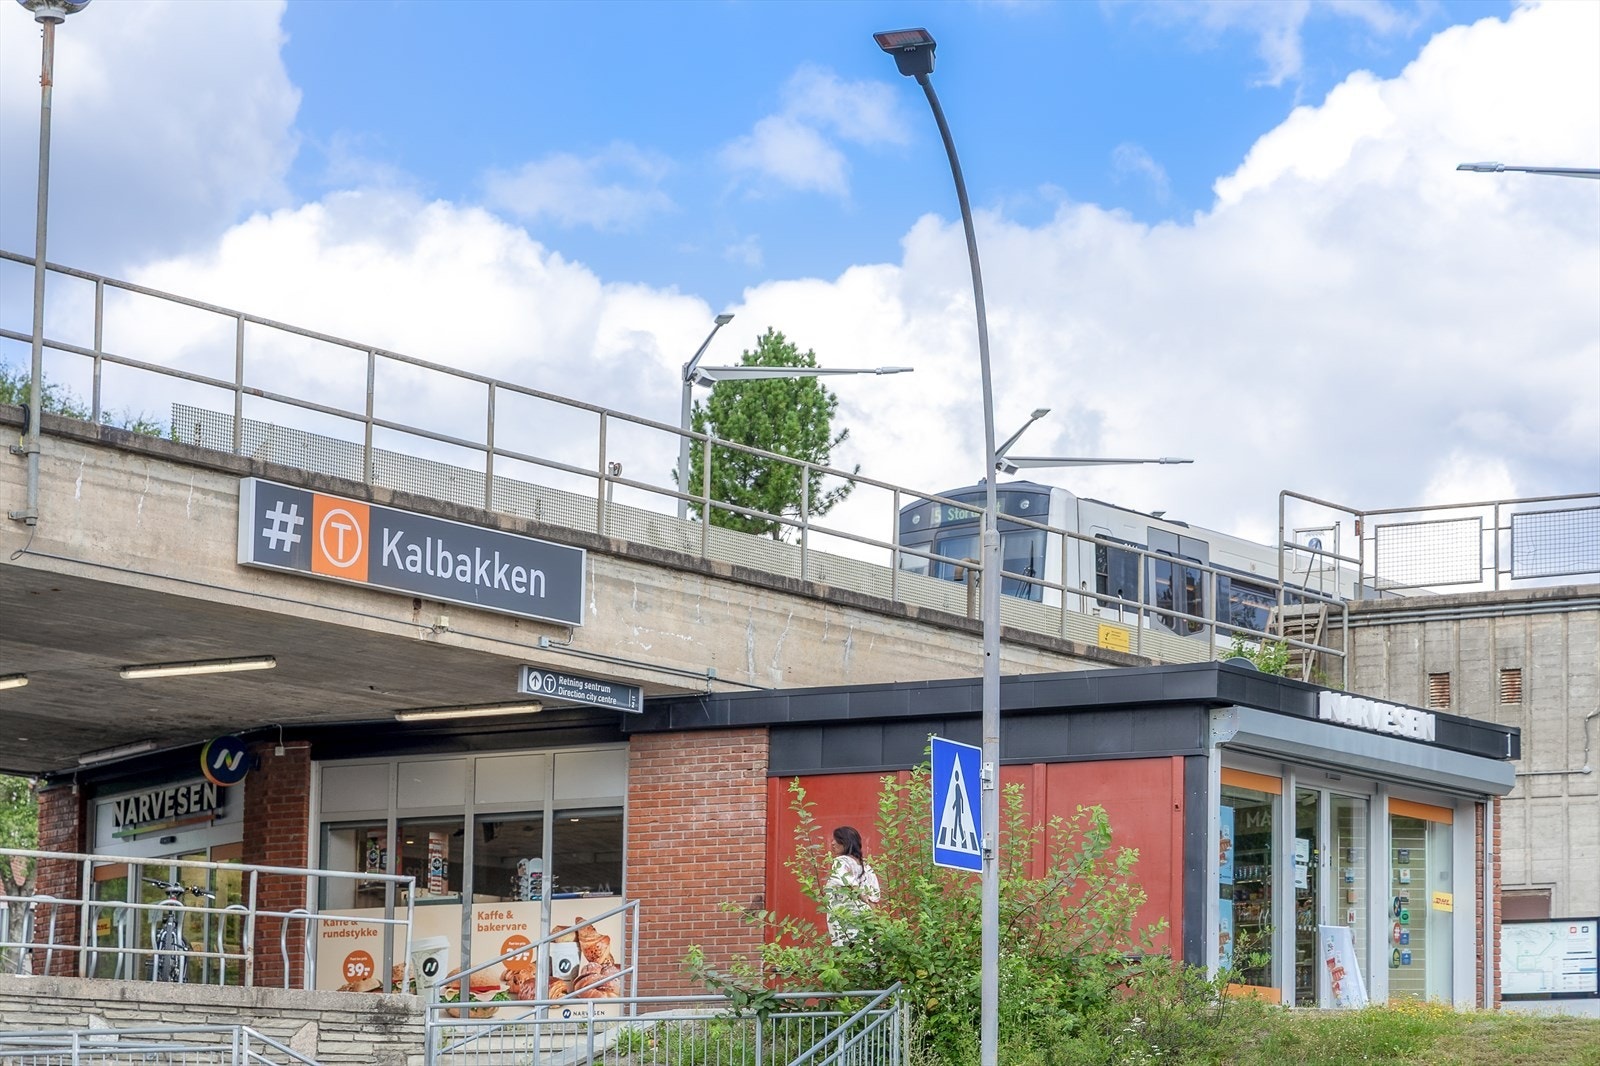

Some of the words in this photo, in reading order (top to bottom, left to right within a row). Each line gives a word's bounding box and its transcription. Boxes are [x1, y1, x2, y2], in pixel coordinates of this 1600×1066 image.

[382, 527, 546, 598] Kalbakken
[558, 675, 583, 689] Retning
[584, 680, 611, 693] sentrum
[558, 687, 585, 699] Direction
[586, 691, 598, 702] city
[598, 694, 617, 705] centre
[1319, 690, 1436, 742] NARVESEN
[112, 782, 218, 828] NARVESEN
[1434, 897, 1451, 906] DHL
[477, 910, 504, 920] Kaffe
[505, 910, 514, 919] &
[323, 928, 378, 940] rundstykke
[477, 923, 527, 932] bakervare
